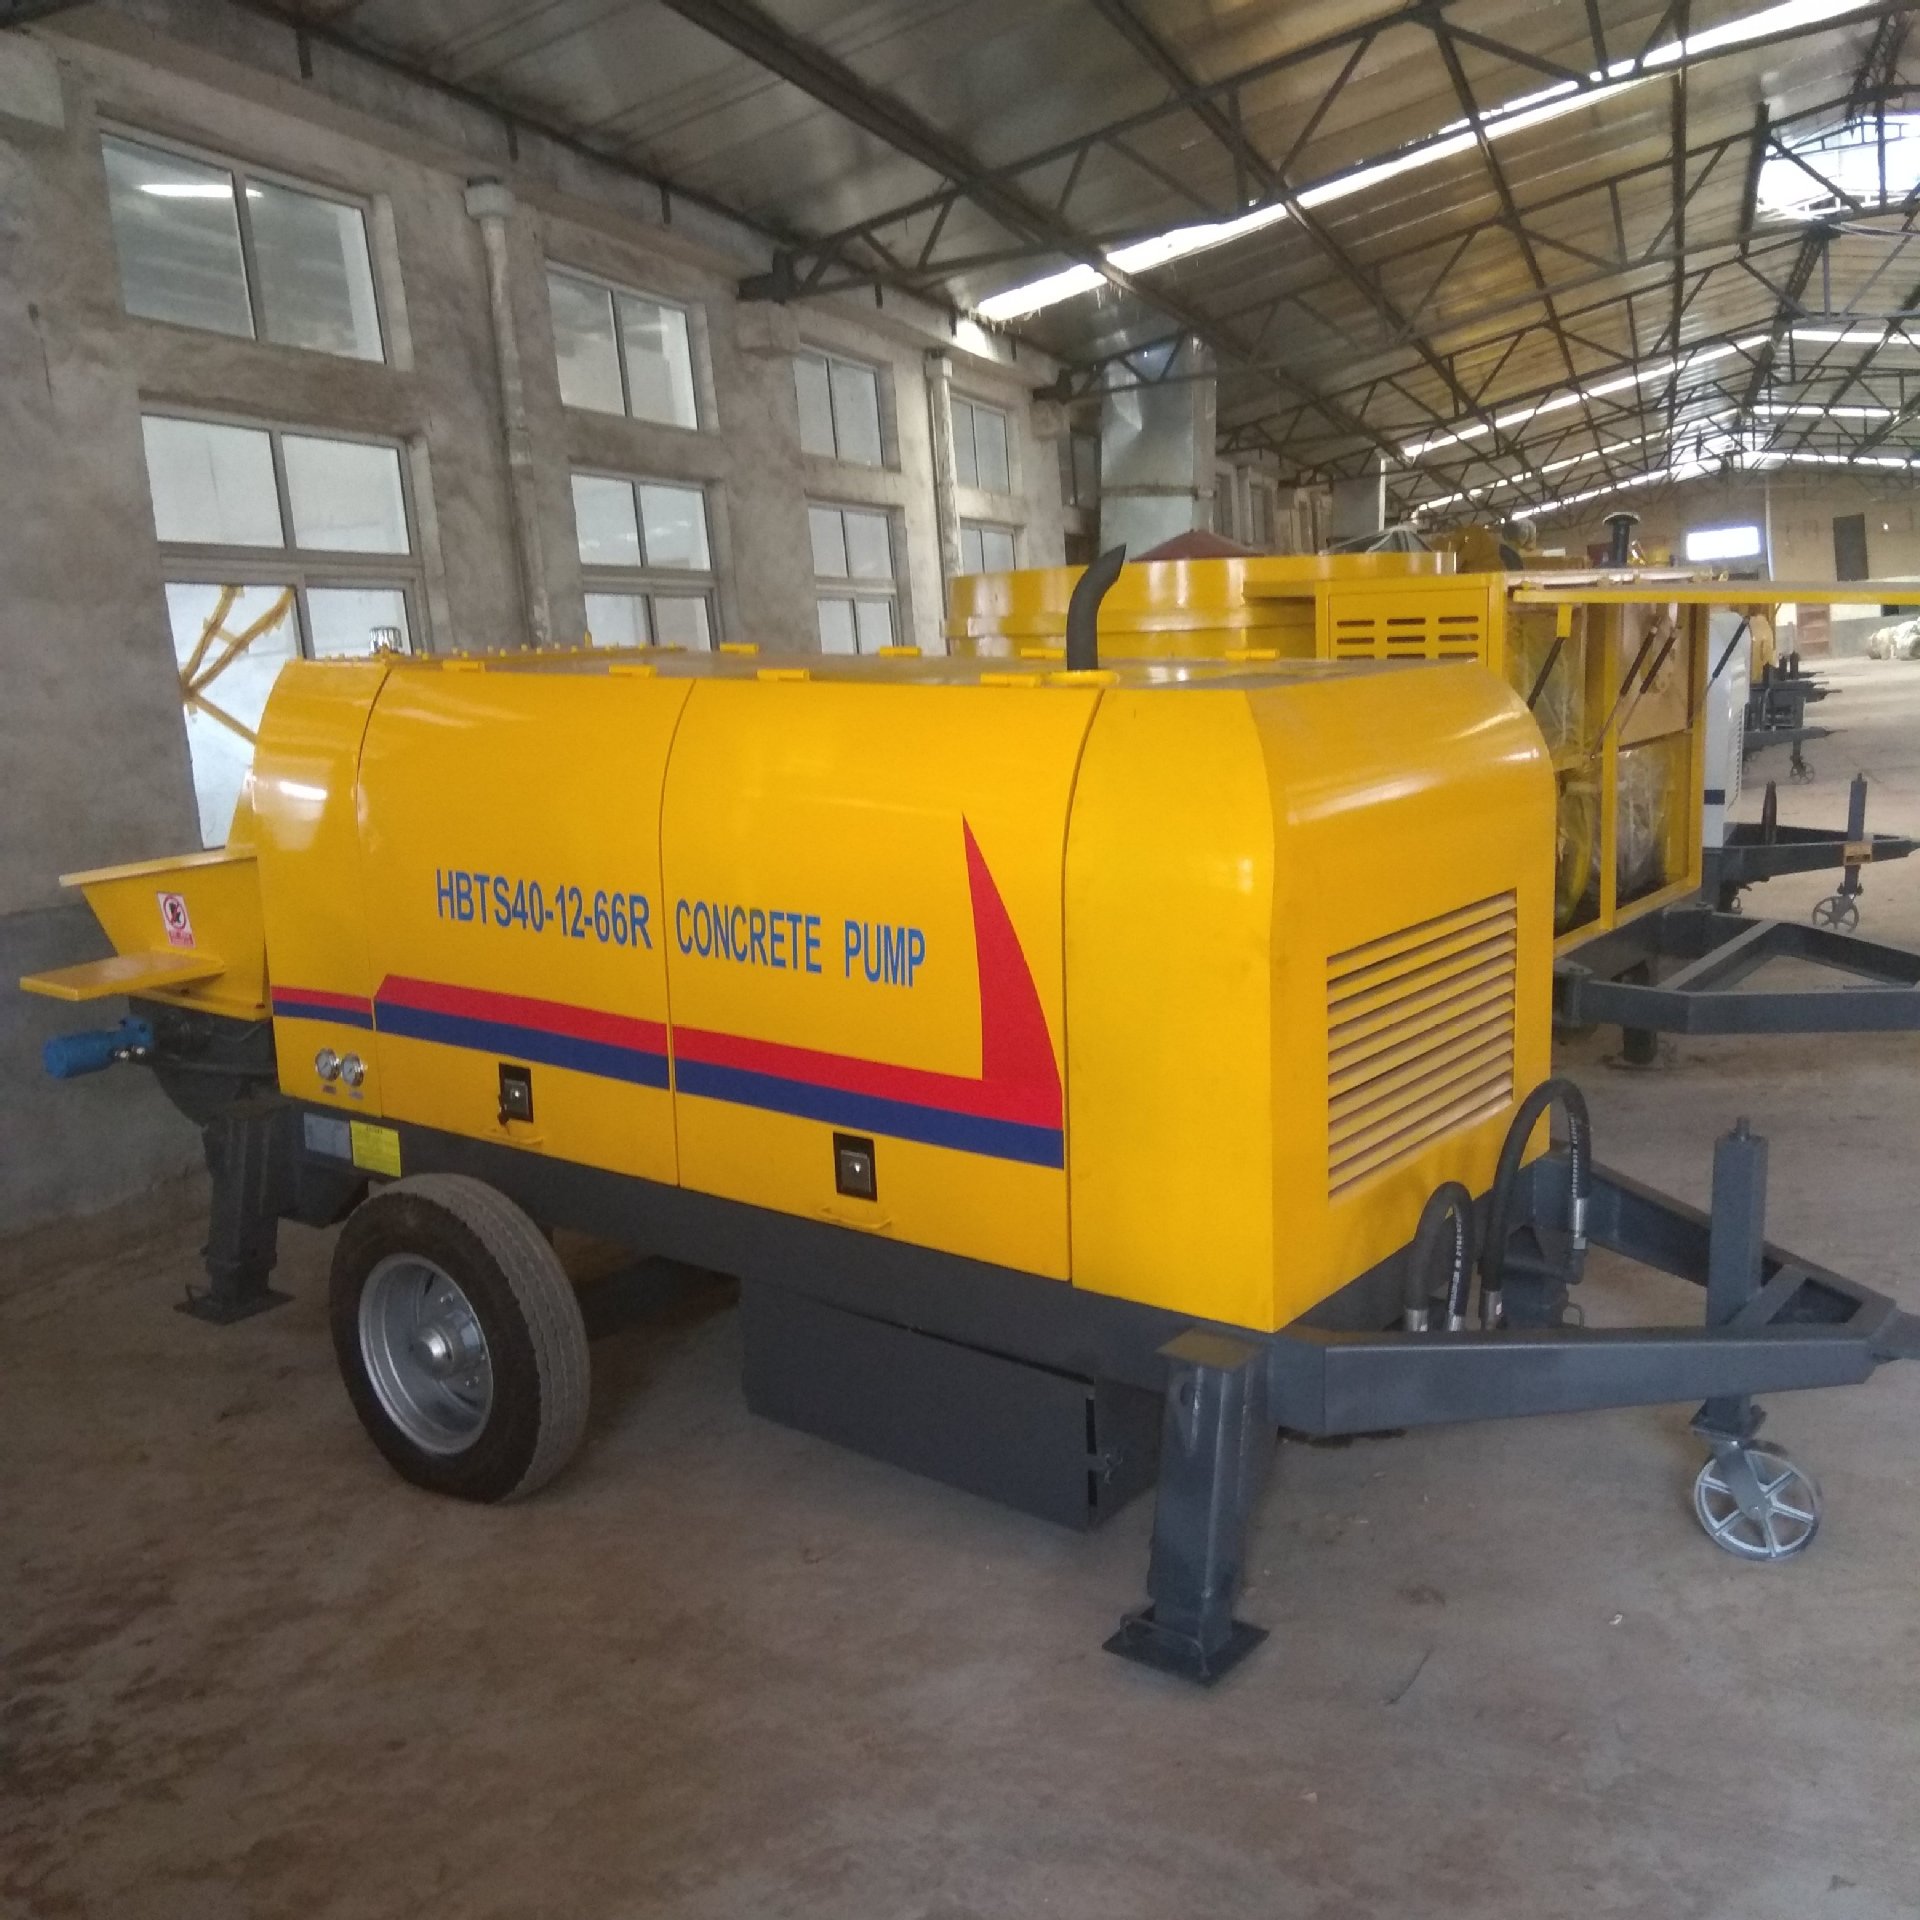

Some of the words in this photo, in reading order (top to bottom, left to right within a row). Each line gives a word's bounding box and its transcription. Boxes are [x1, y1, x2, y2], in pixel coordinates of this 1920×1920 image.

[436, 869, 652, 949] HBTS40-12-66R
[675, 899, 822, 974] CONCRETE
[844, 920, 926, 987] PUMP
